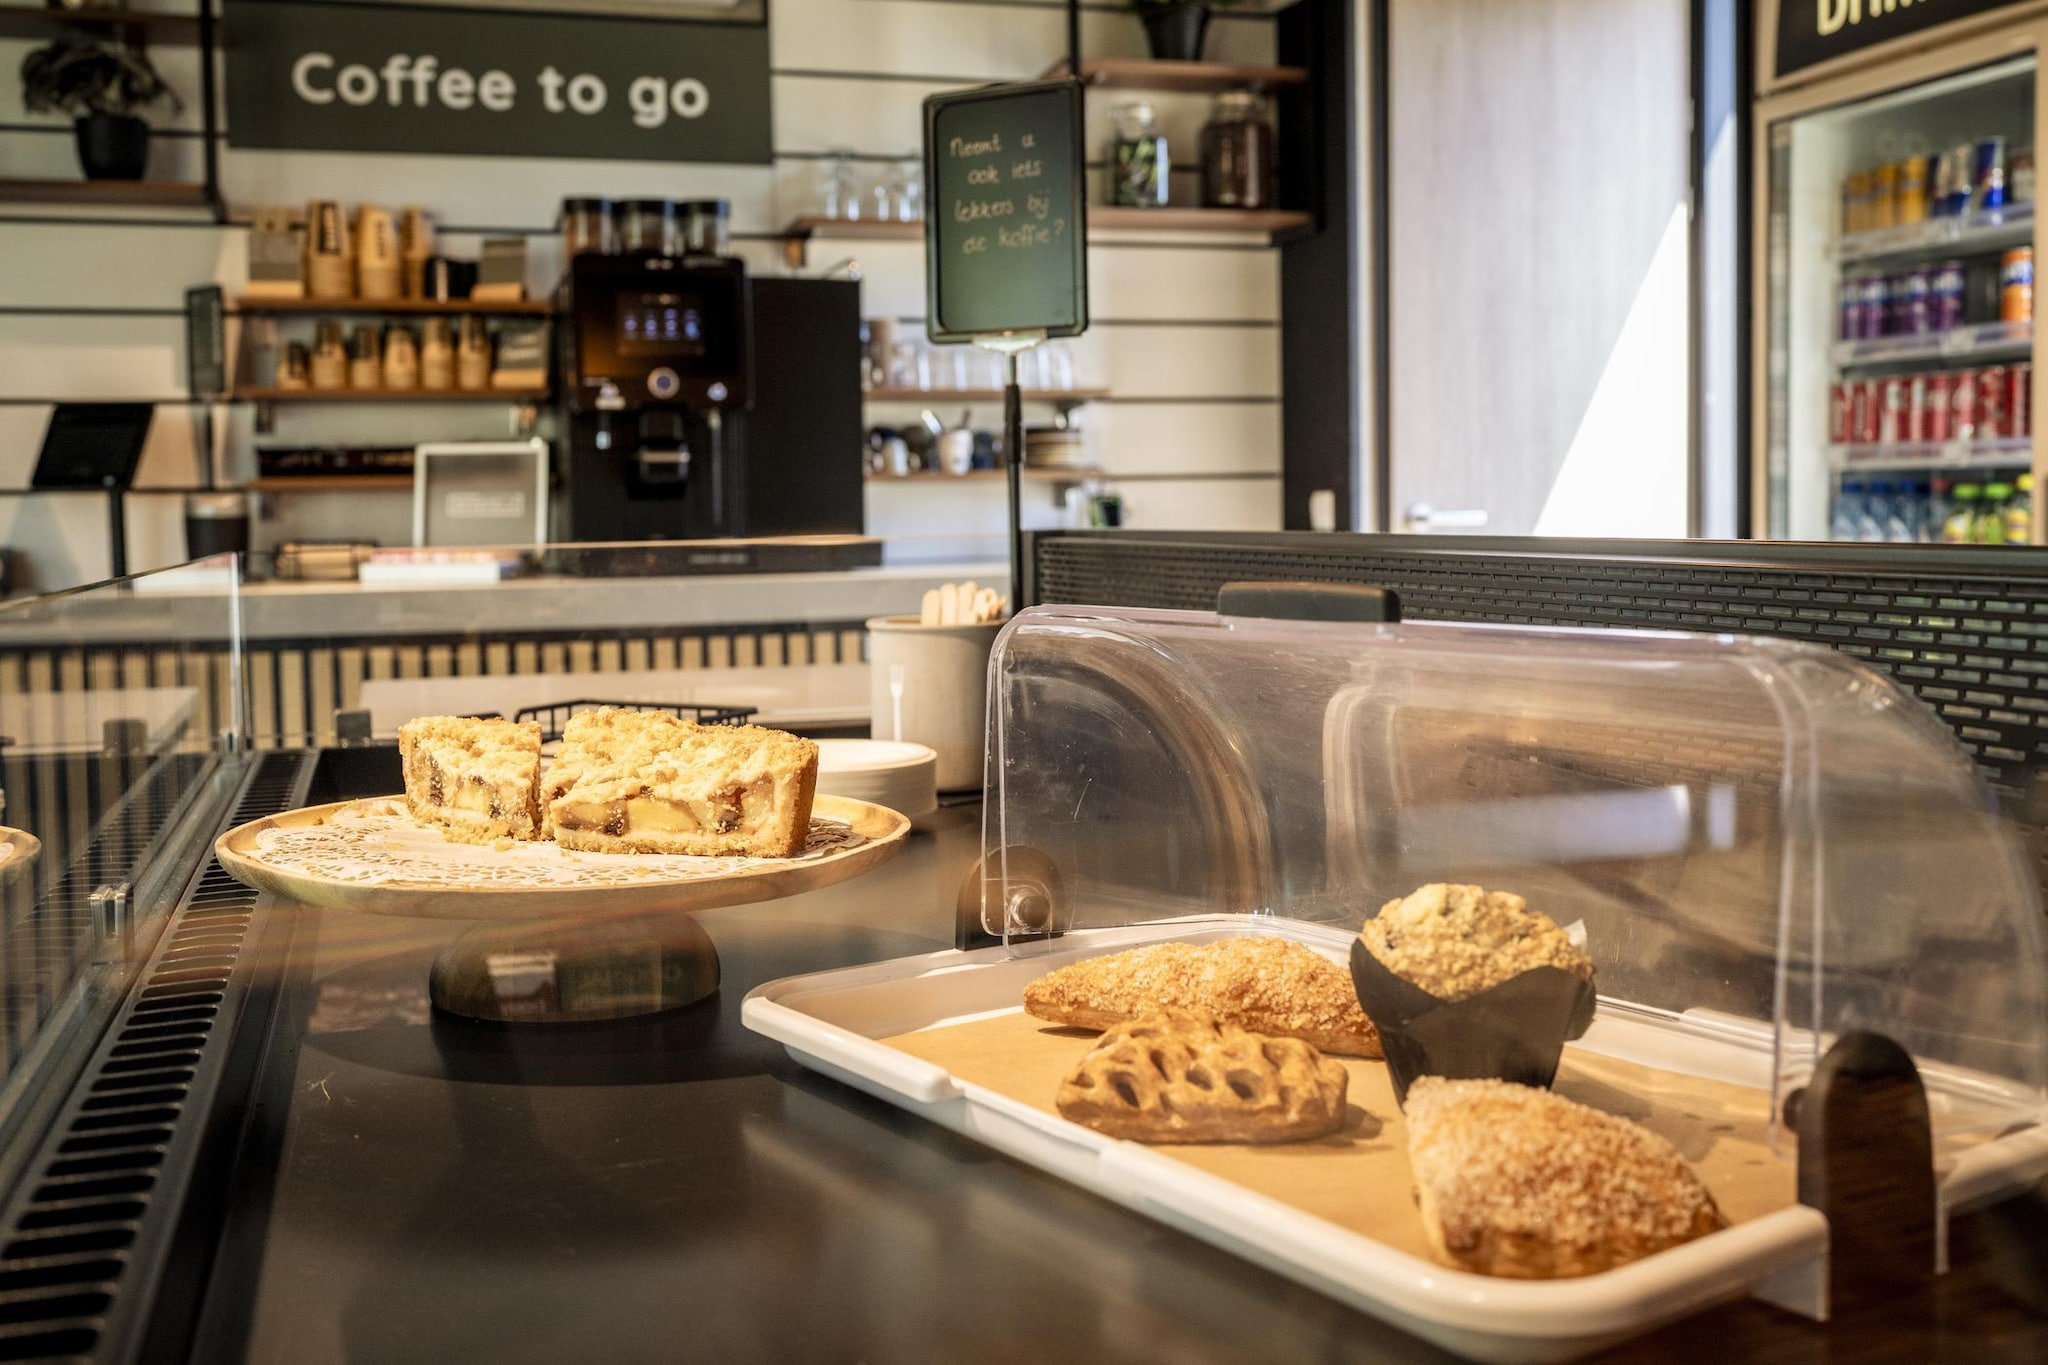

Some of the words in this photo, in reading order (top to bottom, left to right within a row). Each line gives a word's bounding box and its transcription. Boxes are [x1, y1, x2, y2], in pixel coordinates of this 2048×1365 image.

[291, 52, 516, 112] Coffee
[536, 65, 608, 115] to
[628, 75, 709, 128] go
[967, 164, 1000, 185] ook
[1011, 159, 1042, 179] iets
